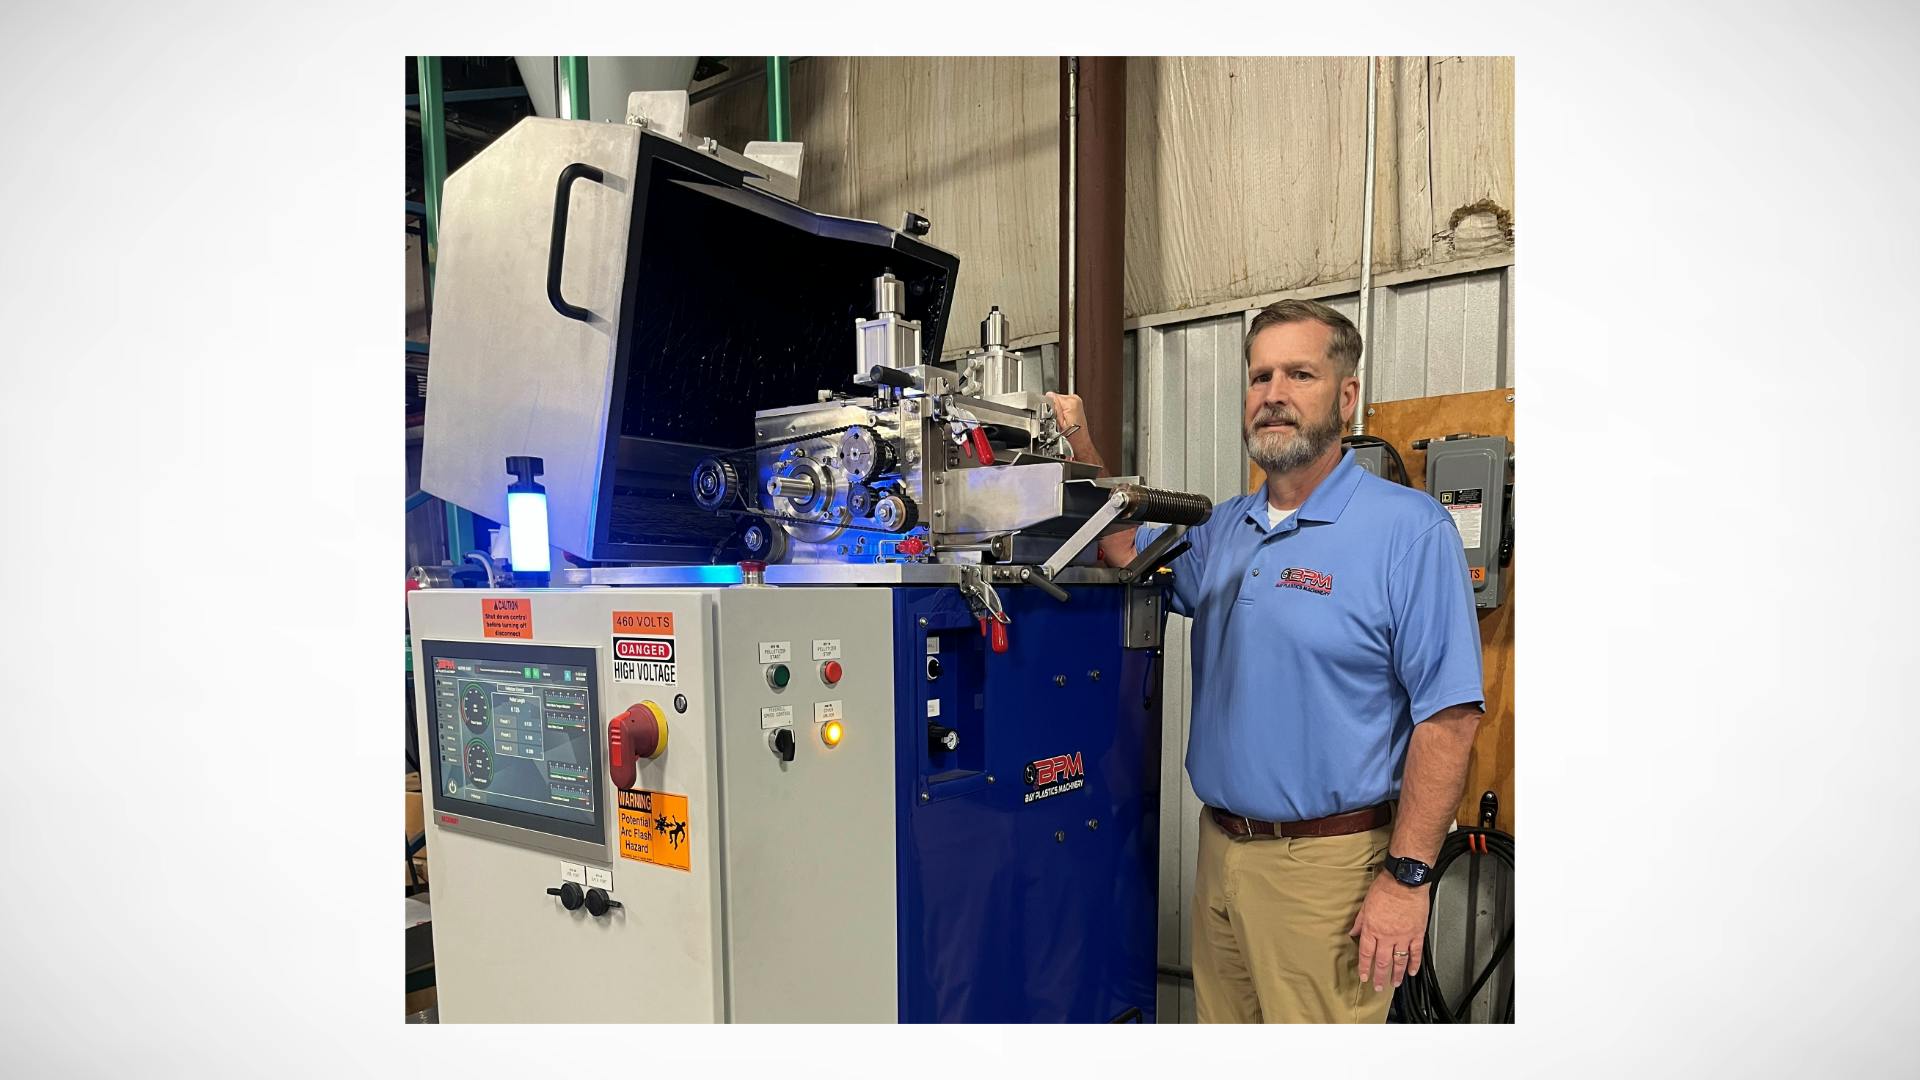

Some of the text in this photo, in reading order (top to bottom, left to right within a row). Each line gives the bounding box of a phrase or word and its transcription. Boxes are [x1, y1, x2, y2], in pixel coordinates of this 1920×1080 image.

[1289, 568, 1333, 590] BPM
[1468, 568, 1480, 579] TS
[498, 600, 519, 610] CAUTION
[502, 622, 519, 630] turning
[616, 616, 670, 628] 460 VOLTS
[621, 643, 665, 656] DANGER
[614, 661, 676, 683] HIGH VOLTAGE
[1033, 751, 1084, 786] BPM
[1024, 779, 1084, 803] BAY PLASTICS MACHINERY
[618, 790, 652, 811] WARNING
[621, 813, 651, 828] Potential
[621, 826, 652, 841] Arc Flash
[625, 840, 649, 854] Hazard
